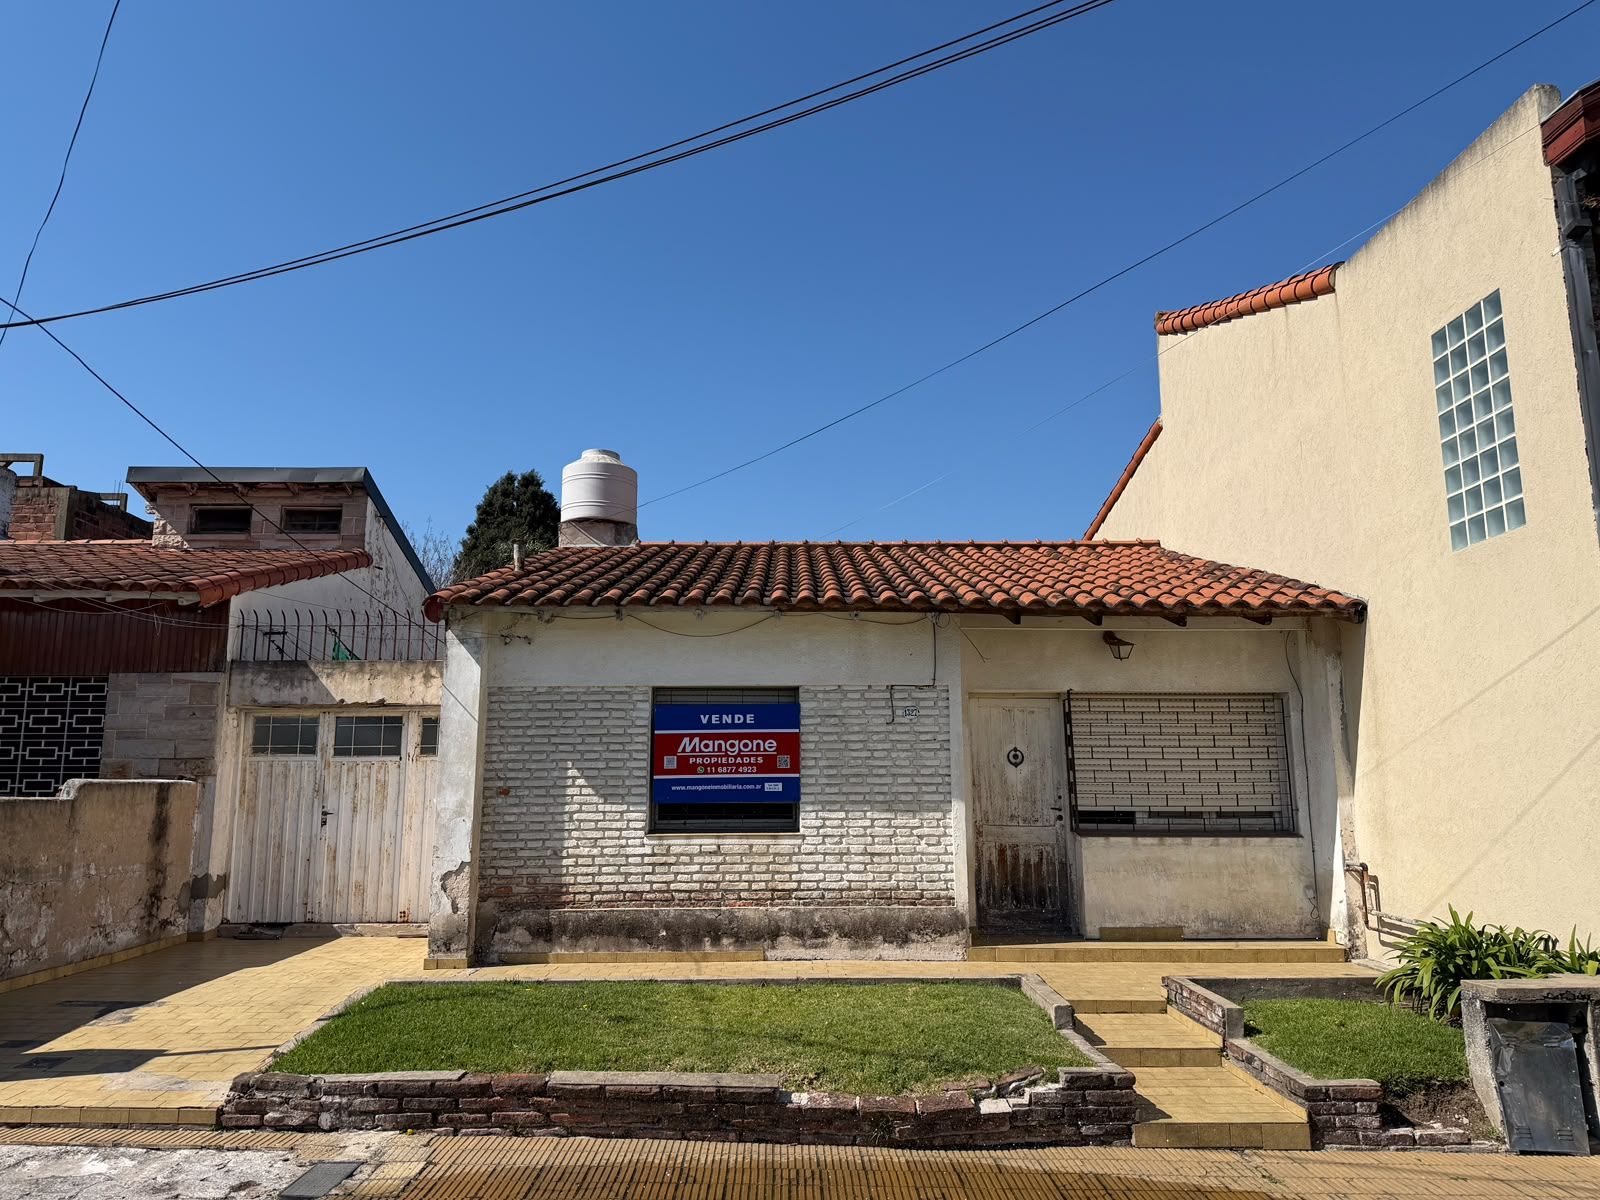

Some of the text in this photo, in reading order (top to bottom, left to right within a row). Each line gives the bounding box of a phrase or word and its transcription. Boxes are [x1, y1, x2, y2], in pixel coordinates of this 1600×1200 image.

[700, 714, 755, 724] VENDE
[677, 736, 777, 756] Mangone
[689, 756, 764, 765] PROPIEDADES
[671, 783, 762, 791] www.mangoneinmobiliaria.com.ar
